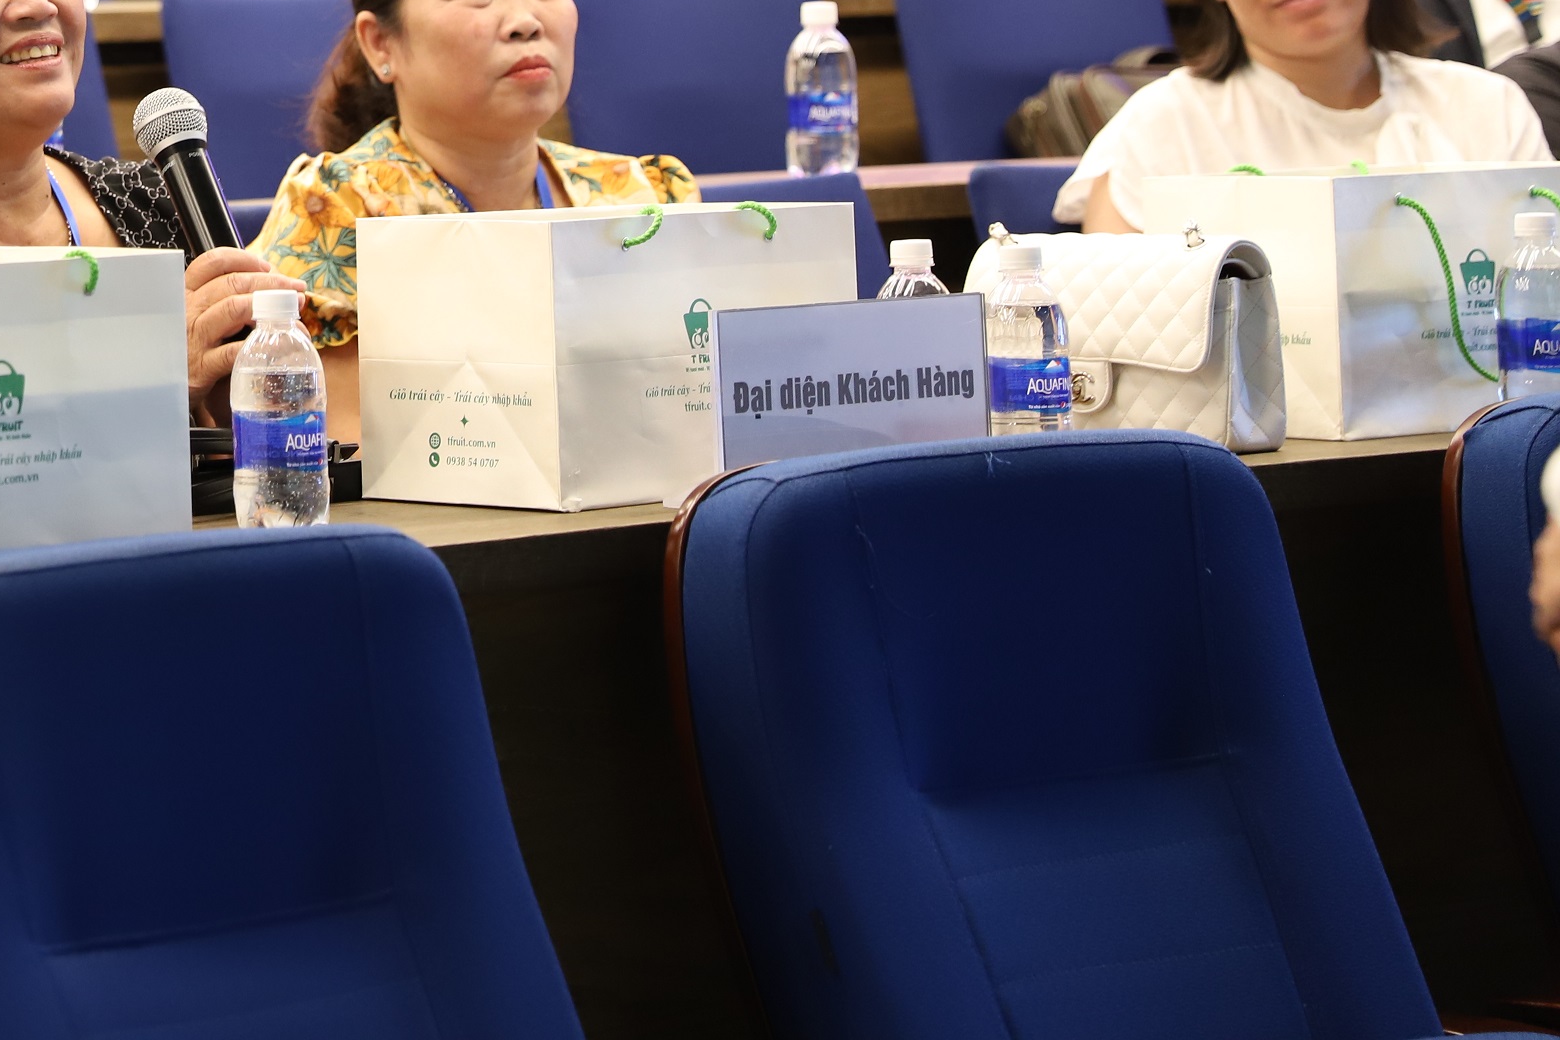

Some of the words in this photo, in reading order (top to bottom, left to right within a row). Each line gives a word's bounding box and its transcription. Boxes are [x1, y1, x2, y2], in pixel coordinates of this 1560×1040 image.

[1533, 338, 1560, 358] AQU
[691, 354, 697, 364] T
[660, 384, 676, 397] trái
[677, 384, 690, 397] cây
[698, 382, 711, 393] Trá
[733, 379, 772, 419] Đại
[780, 375, 831, 415] diện
[837, 369, 910, 406] Khách
[916, 365, 975, 399] Hàng
[1026, 377, 1071, 396] AQUAFIN
[409, 388, 427, 401] trái
[429, 389, 445, 403] cây
[453, 390, 472, 403] Trái
[473, 392, 490, 406] cây
[491, 392, 511, 408] nhập
[284, 433, 325, 453] AQUAFI
[447, 436, 496, 449] tfruit.com.vn
[34, 450, 57, 464] nhập
[446, 455, 466, 467] 0938
[468, 457, 478, 467] 54
[479, 458, 500, 469] 0707
